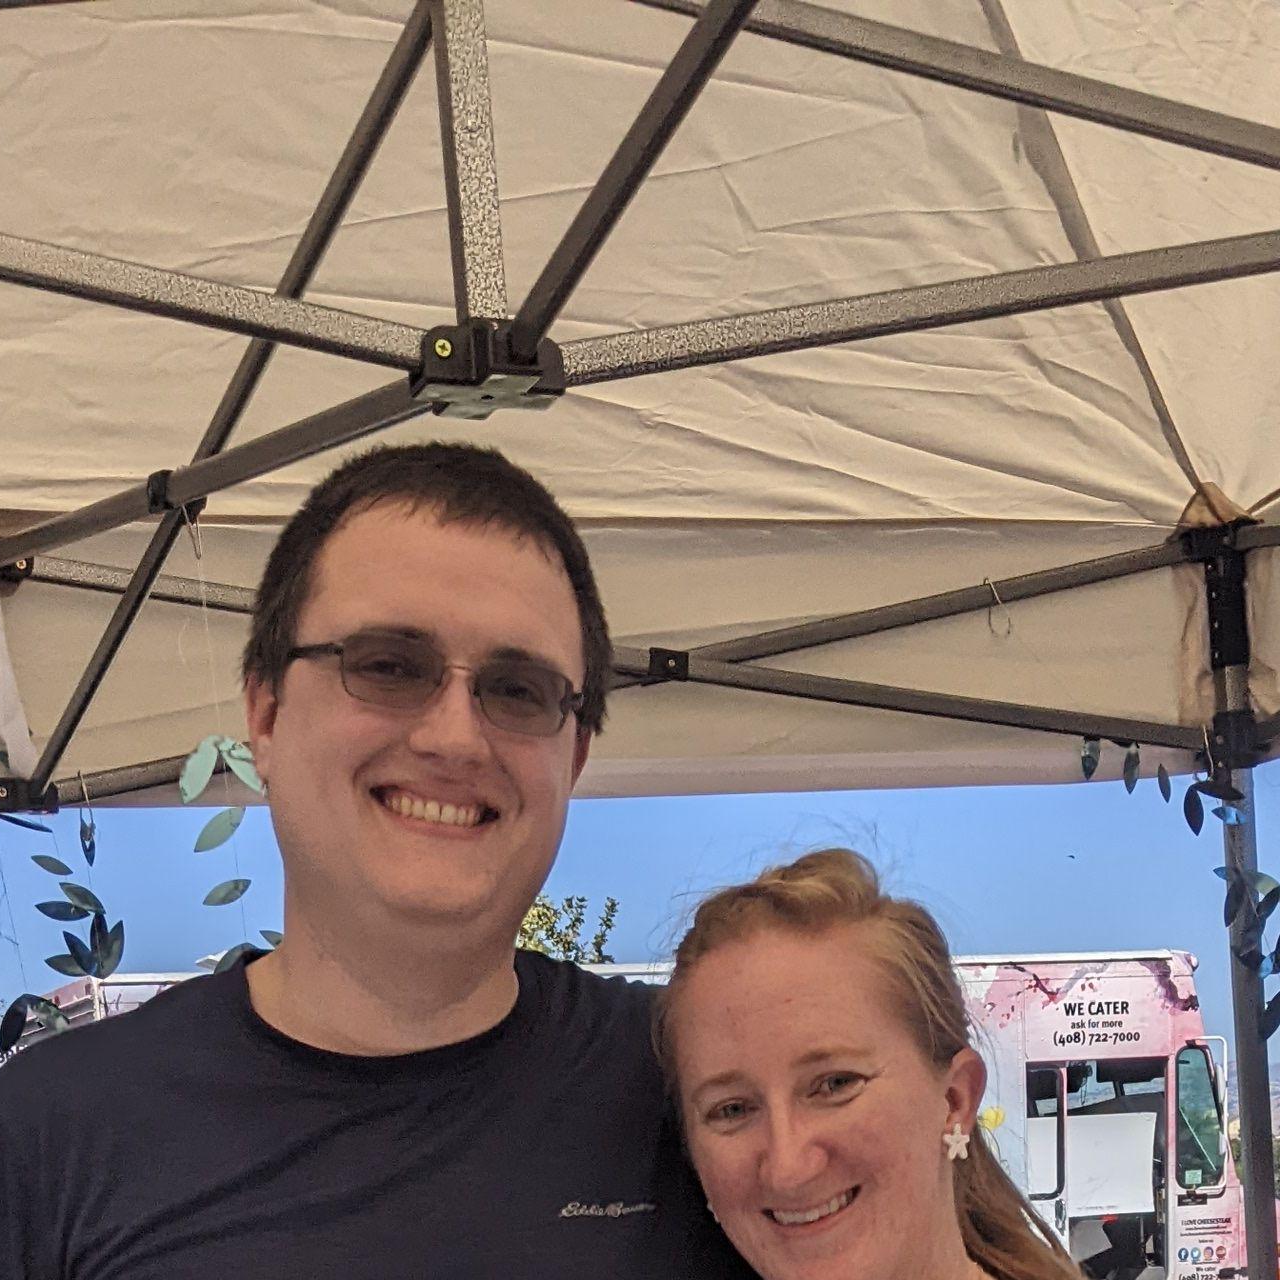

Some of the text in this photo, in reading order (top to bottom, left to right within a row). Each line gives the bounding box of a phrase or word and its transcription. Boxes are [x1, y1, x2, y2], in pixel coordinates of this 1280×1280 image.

[1063, 1001, 1130, 1017] WE CATER
[1070, 1019, 1123, 1029] ask for more
[1053, 1030, 1141, 1047] (408) 722-7000
